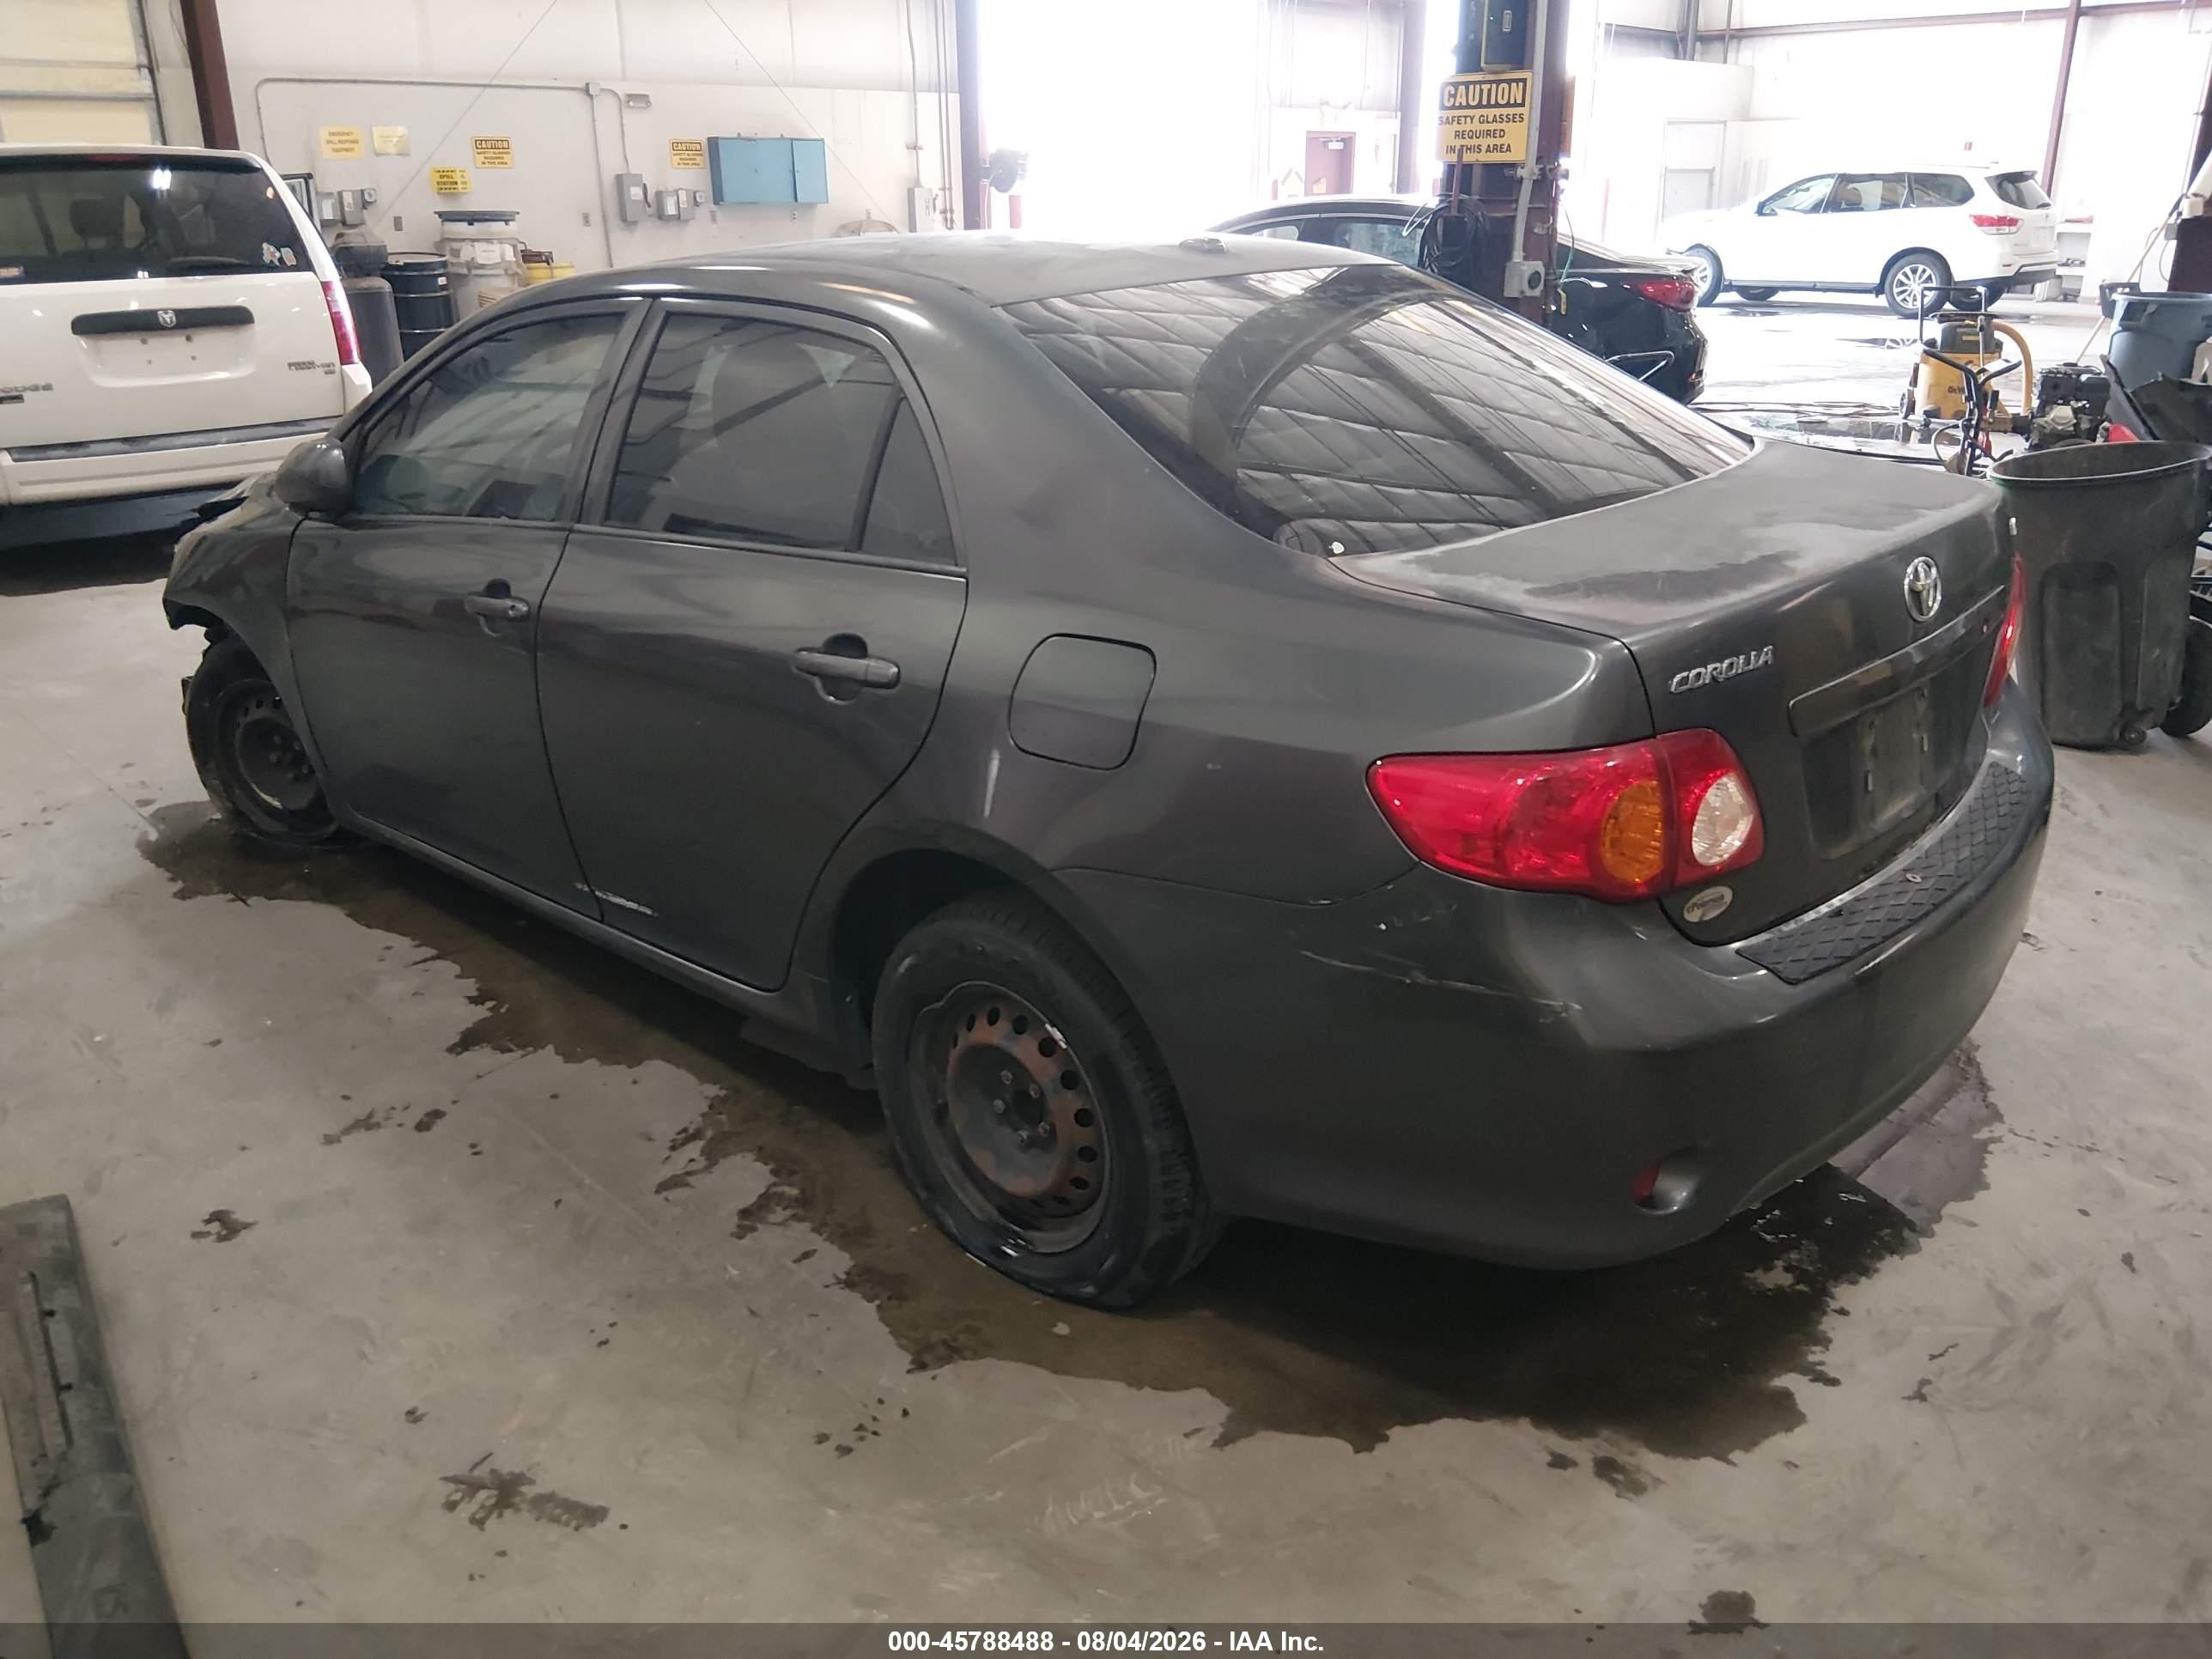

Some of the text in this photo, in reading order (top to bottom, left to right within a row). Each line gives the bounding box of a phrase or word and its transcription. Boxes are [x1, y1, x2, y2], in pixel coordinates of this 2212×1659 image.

[1443, 82, 1523, 107] CAUTION
[1438, 112, 1525, 125] SAFETY GLASSES
[1454, 129, 1505, 140] REQUIRED
[477, 140, 508, 149] CAUTION
[673, 143, 701, 151] CAUTION
[1445, 143, 1511, 155] IN THIS AREA
[1670, 645, 1773, 694] COROLLA
